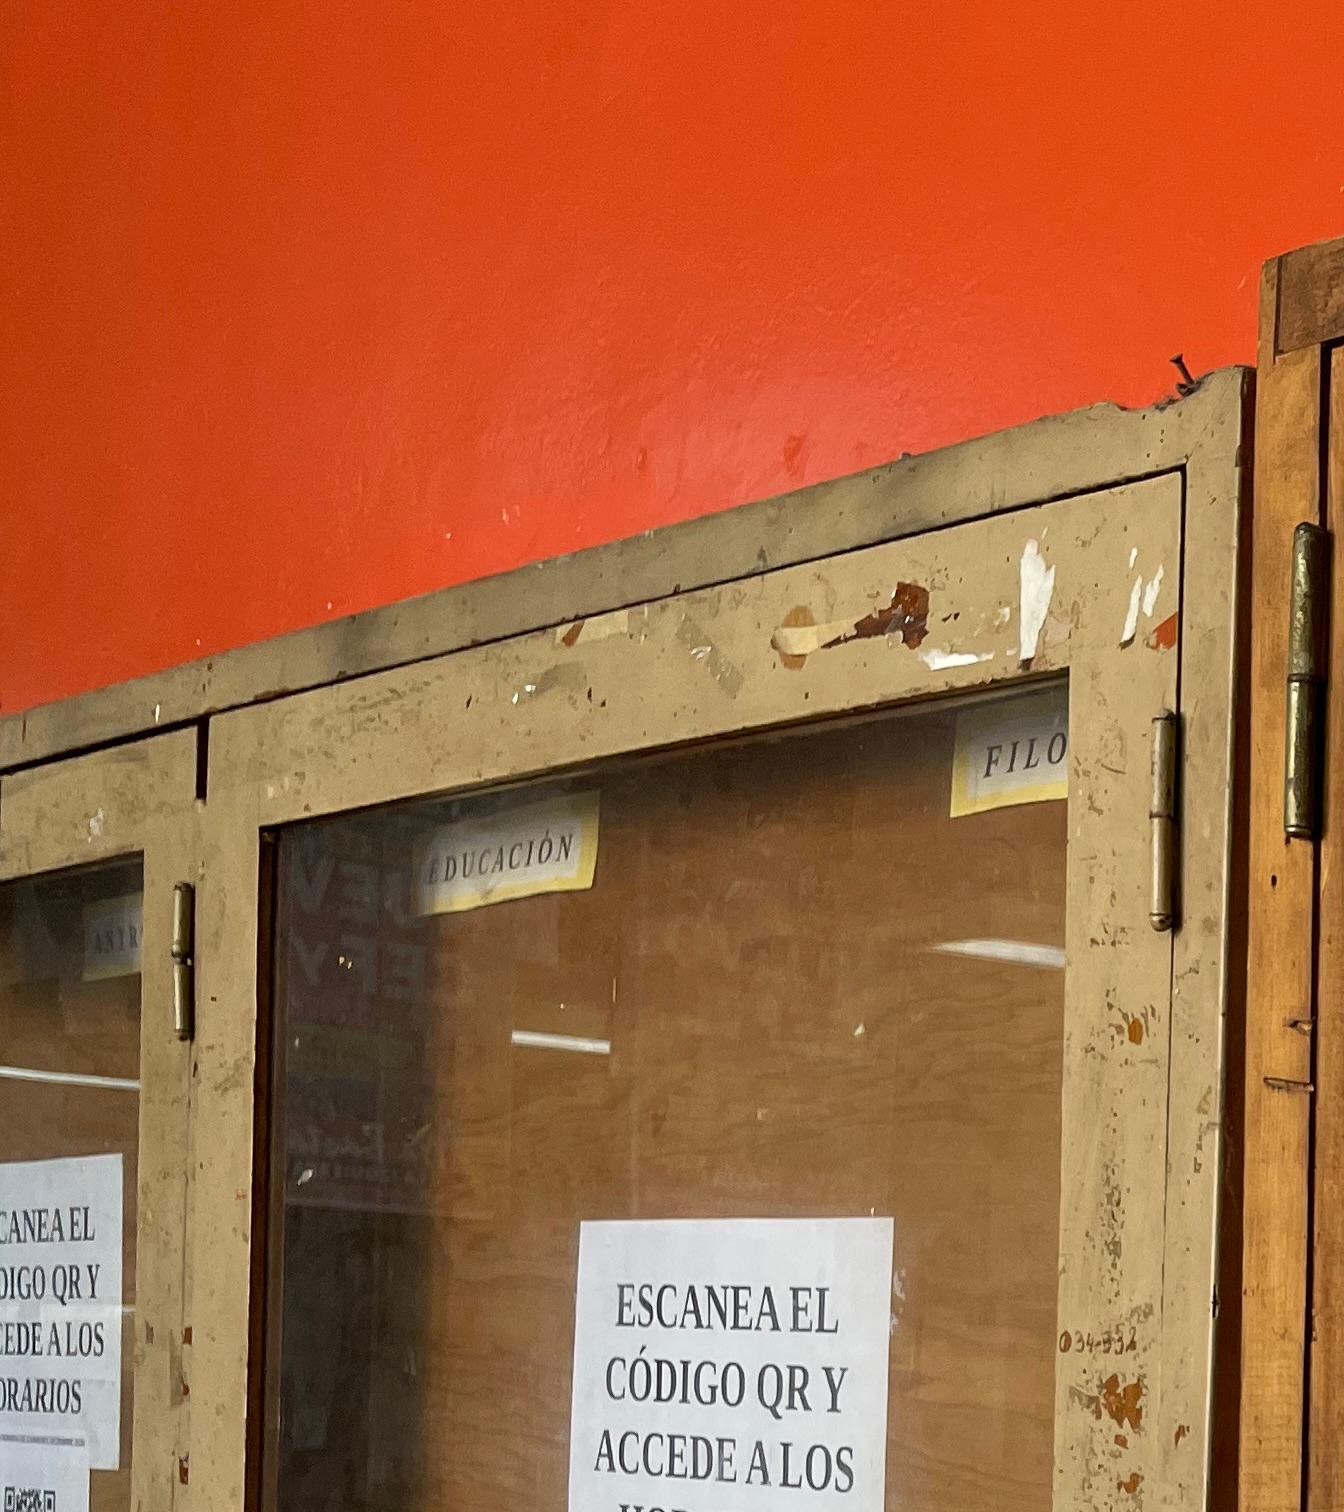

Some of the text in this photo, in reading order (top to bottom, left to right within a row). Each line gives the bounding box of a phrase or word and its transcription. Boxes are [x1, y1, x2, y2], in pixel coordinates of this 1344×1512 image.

[428, 831, 573, 884] EDUCACIÓN
[69, 1206, 95, 1241] EL
[51, 1264, 81, 1306] QR
[87, 1264, 100, 1299] Y
[615, 1283, 839, 1334] ESCANEA EL
[0, 1321, 104, 1357] EDE A LOS
[605, 1344, 849, 1420] CÓDIGO QR Y
[593, 1428, 855, 1493] ACCEDE A LOS
